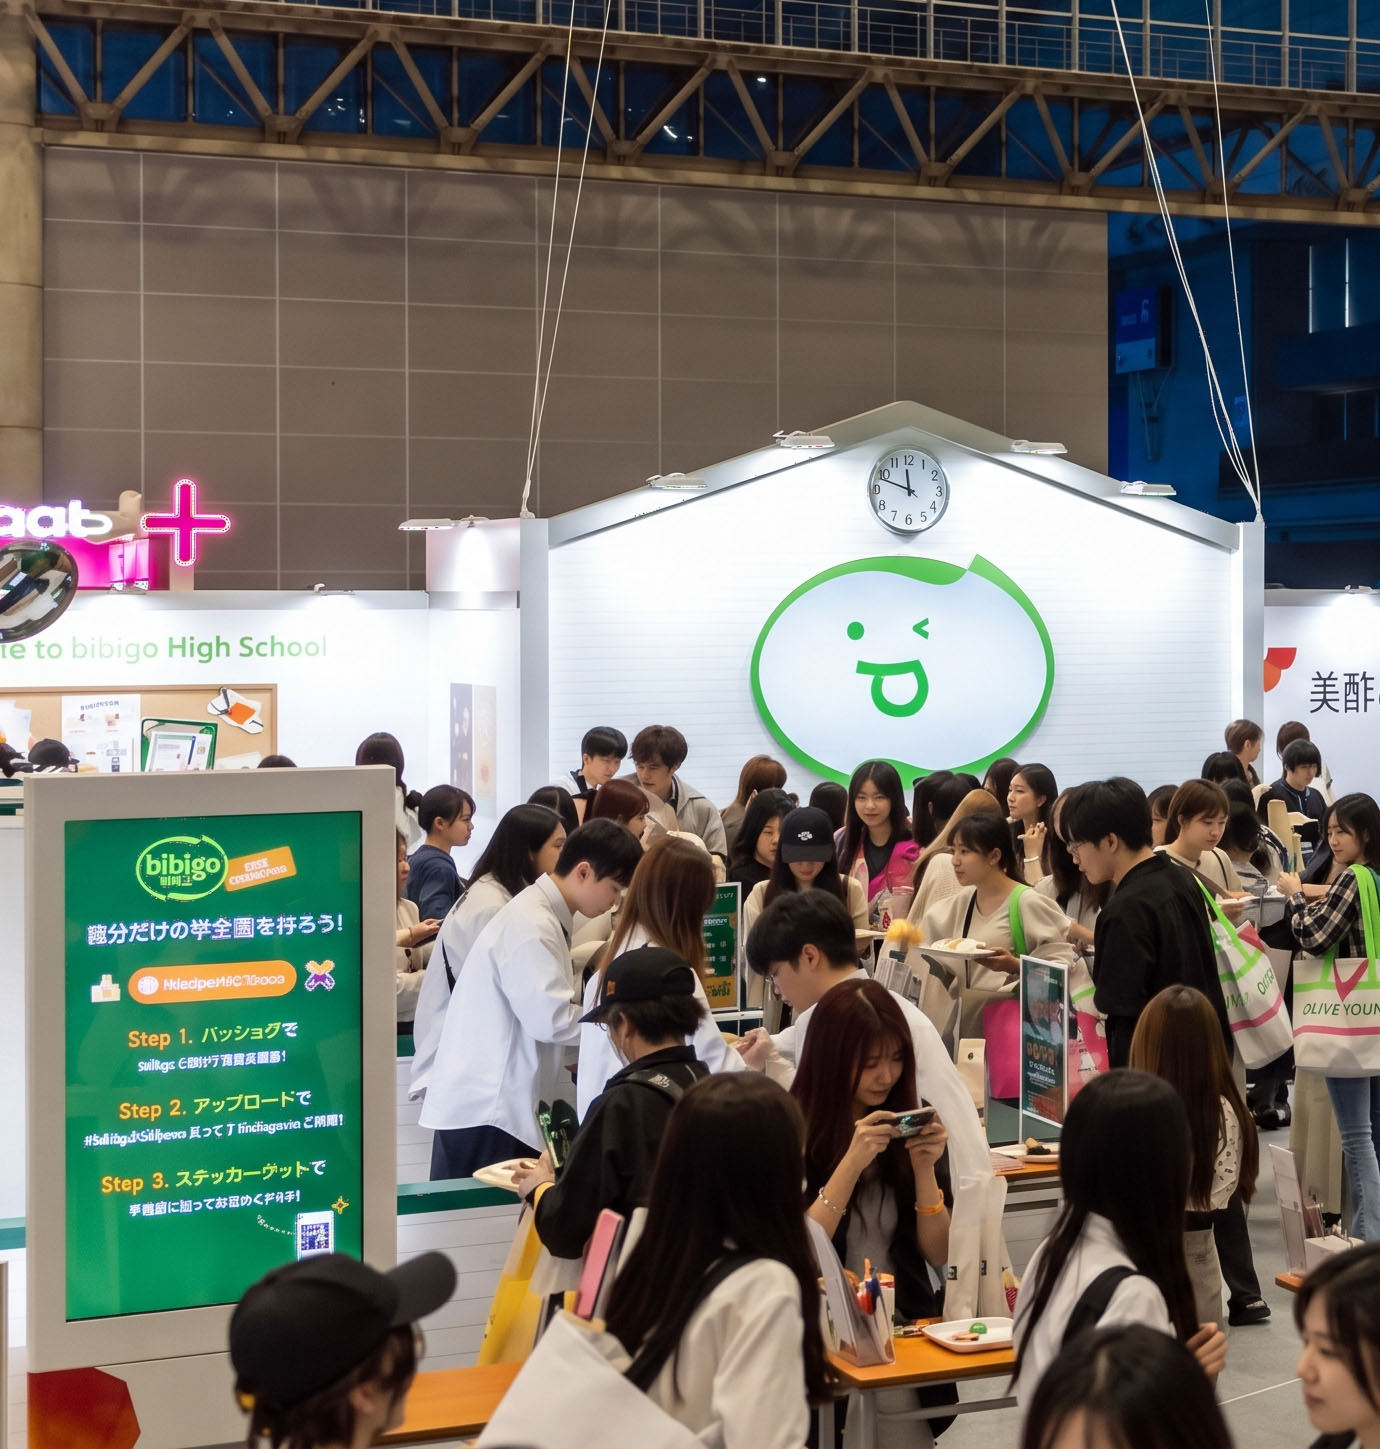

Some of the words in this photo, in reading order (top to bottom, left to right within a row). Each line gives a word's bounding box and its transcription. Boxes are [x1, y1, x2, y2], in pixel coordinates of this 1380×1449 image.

[35, 640, 63, 660] to
[72, 636, 159, 664] bibigo
[169, 636, 231, 664] High
[239, 635, 327, 658] School
[1309, 671, 1375, 714] 美酢
[145, 853, 221, 881] bibigo
[1303, 1003, 1340, 1016] OLIVE
[128, 1030, 171, 1050] Step
[179, 1028, 193, 1044] 1.
[119, 1102, 162, 1121] Step
[169, 1099, 187, 1116] 2.
[101, 1176, 144, 1195] Step
[151, 1172, 169, 1189] 3.
